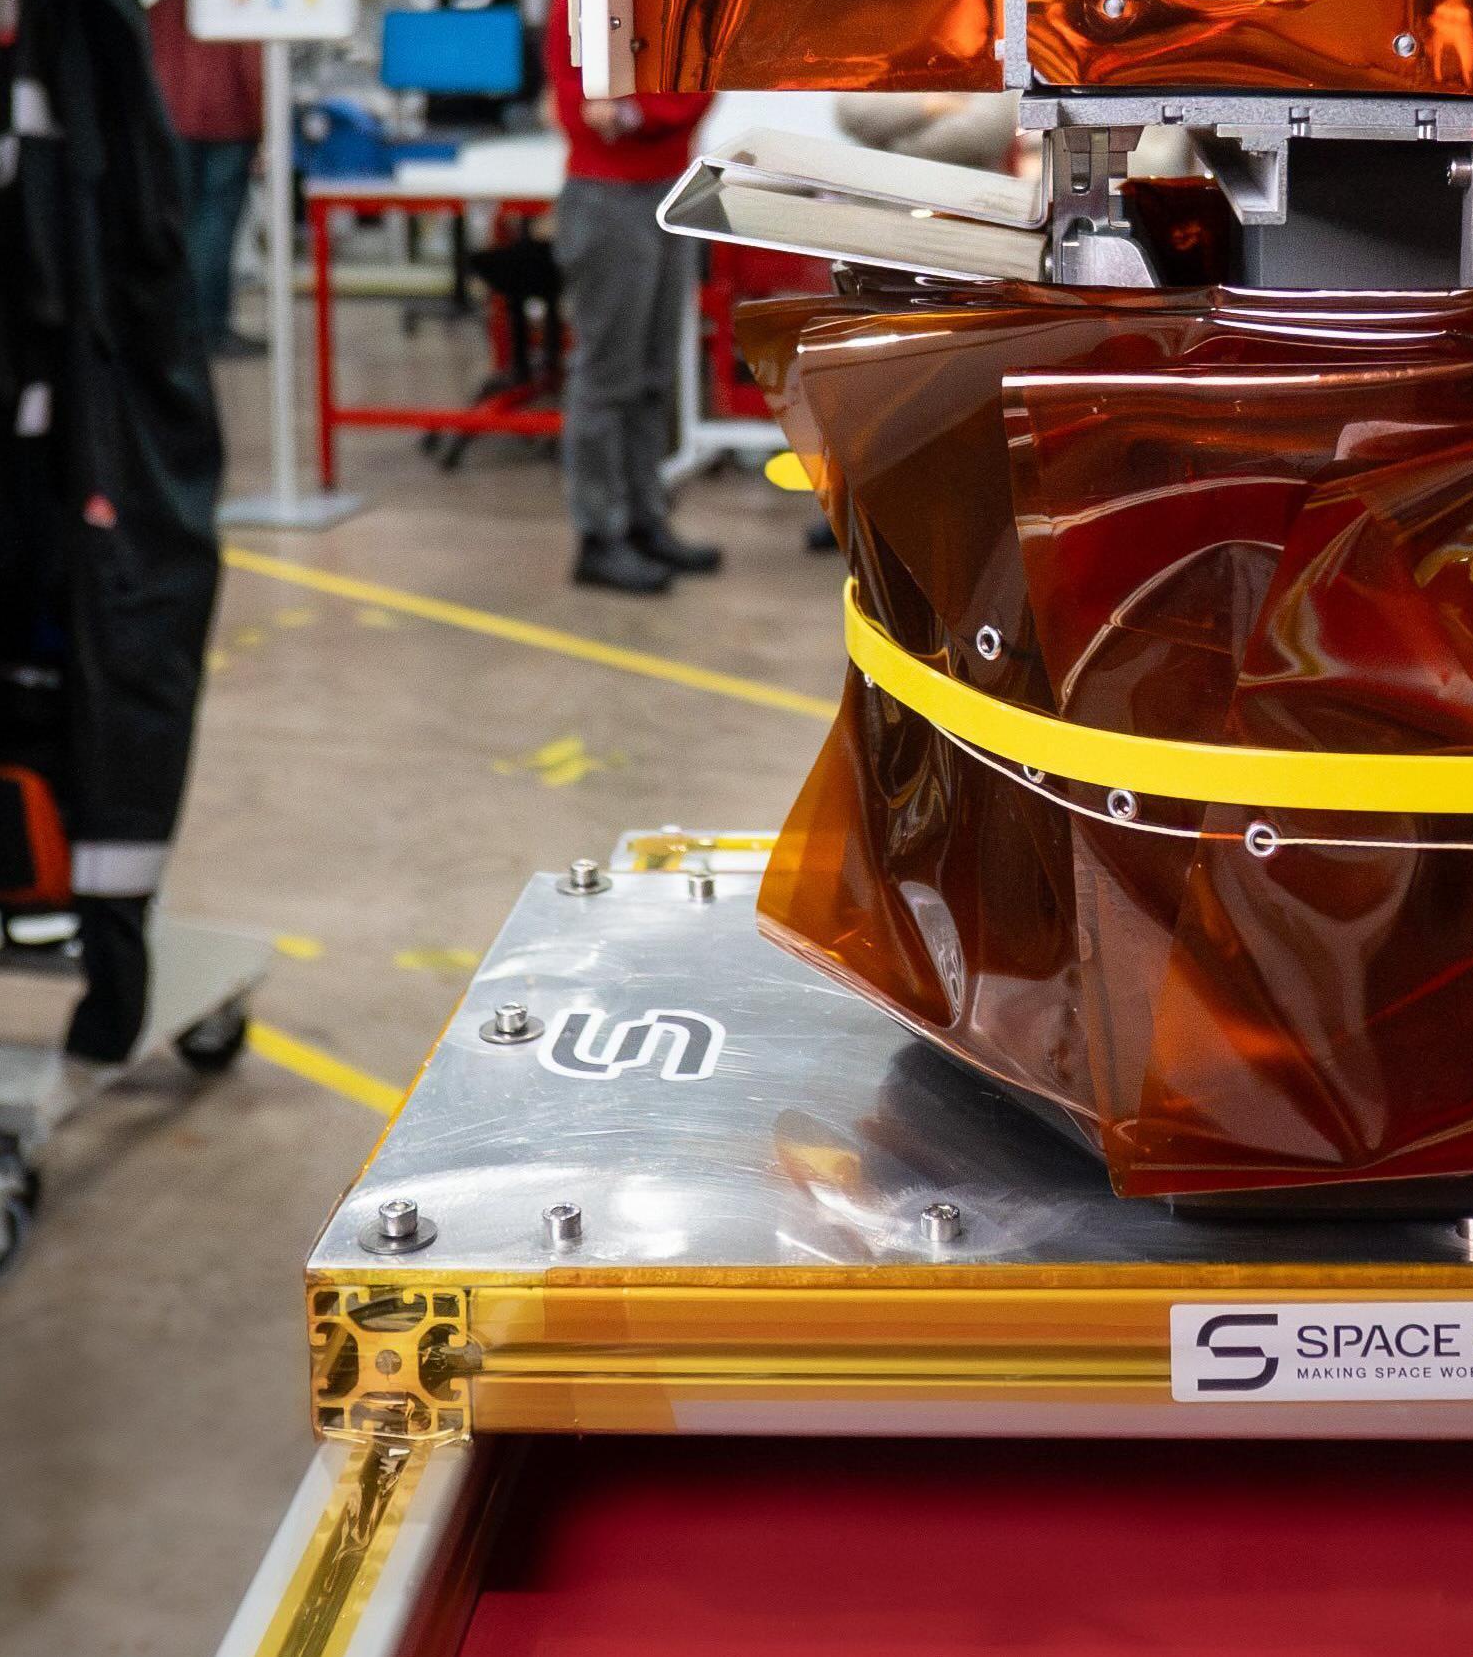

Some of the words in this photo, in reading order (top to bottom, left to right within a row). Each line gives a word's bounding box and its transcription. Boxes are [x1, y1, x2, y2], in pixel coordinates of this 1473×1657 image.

[1296, 1323, 1461, 1358] SPACE
[1297, 1366, 1367, 1379] MAKING
[1375, 1365, 1432, 1379] SPACE
